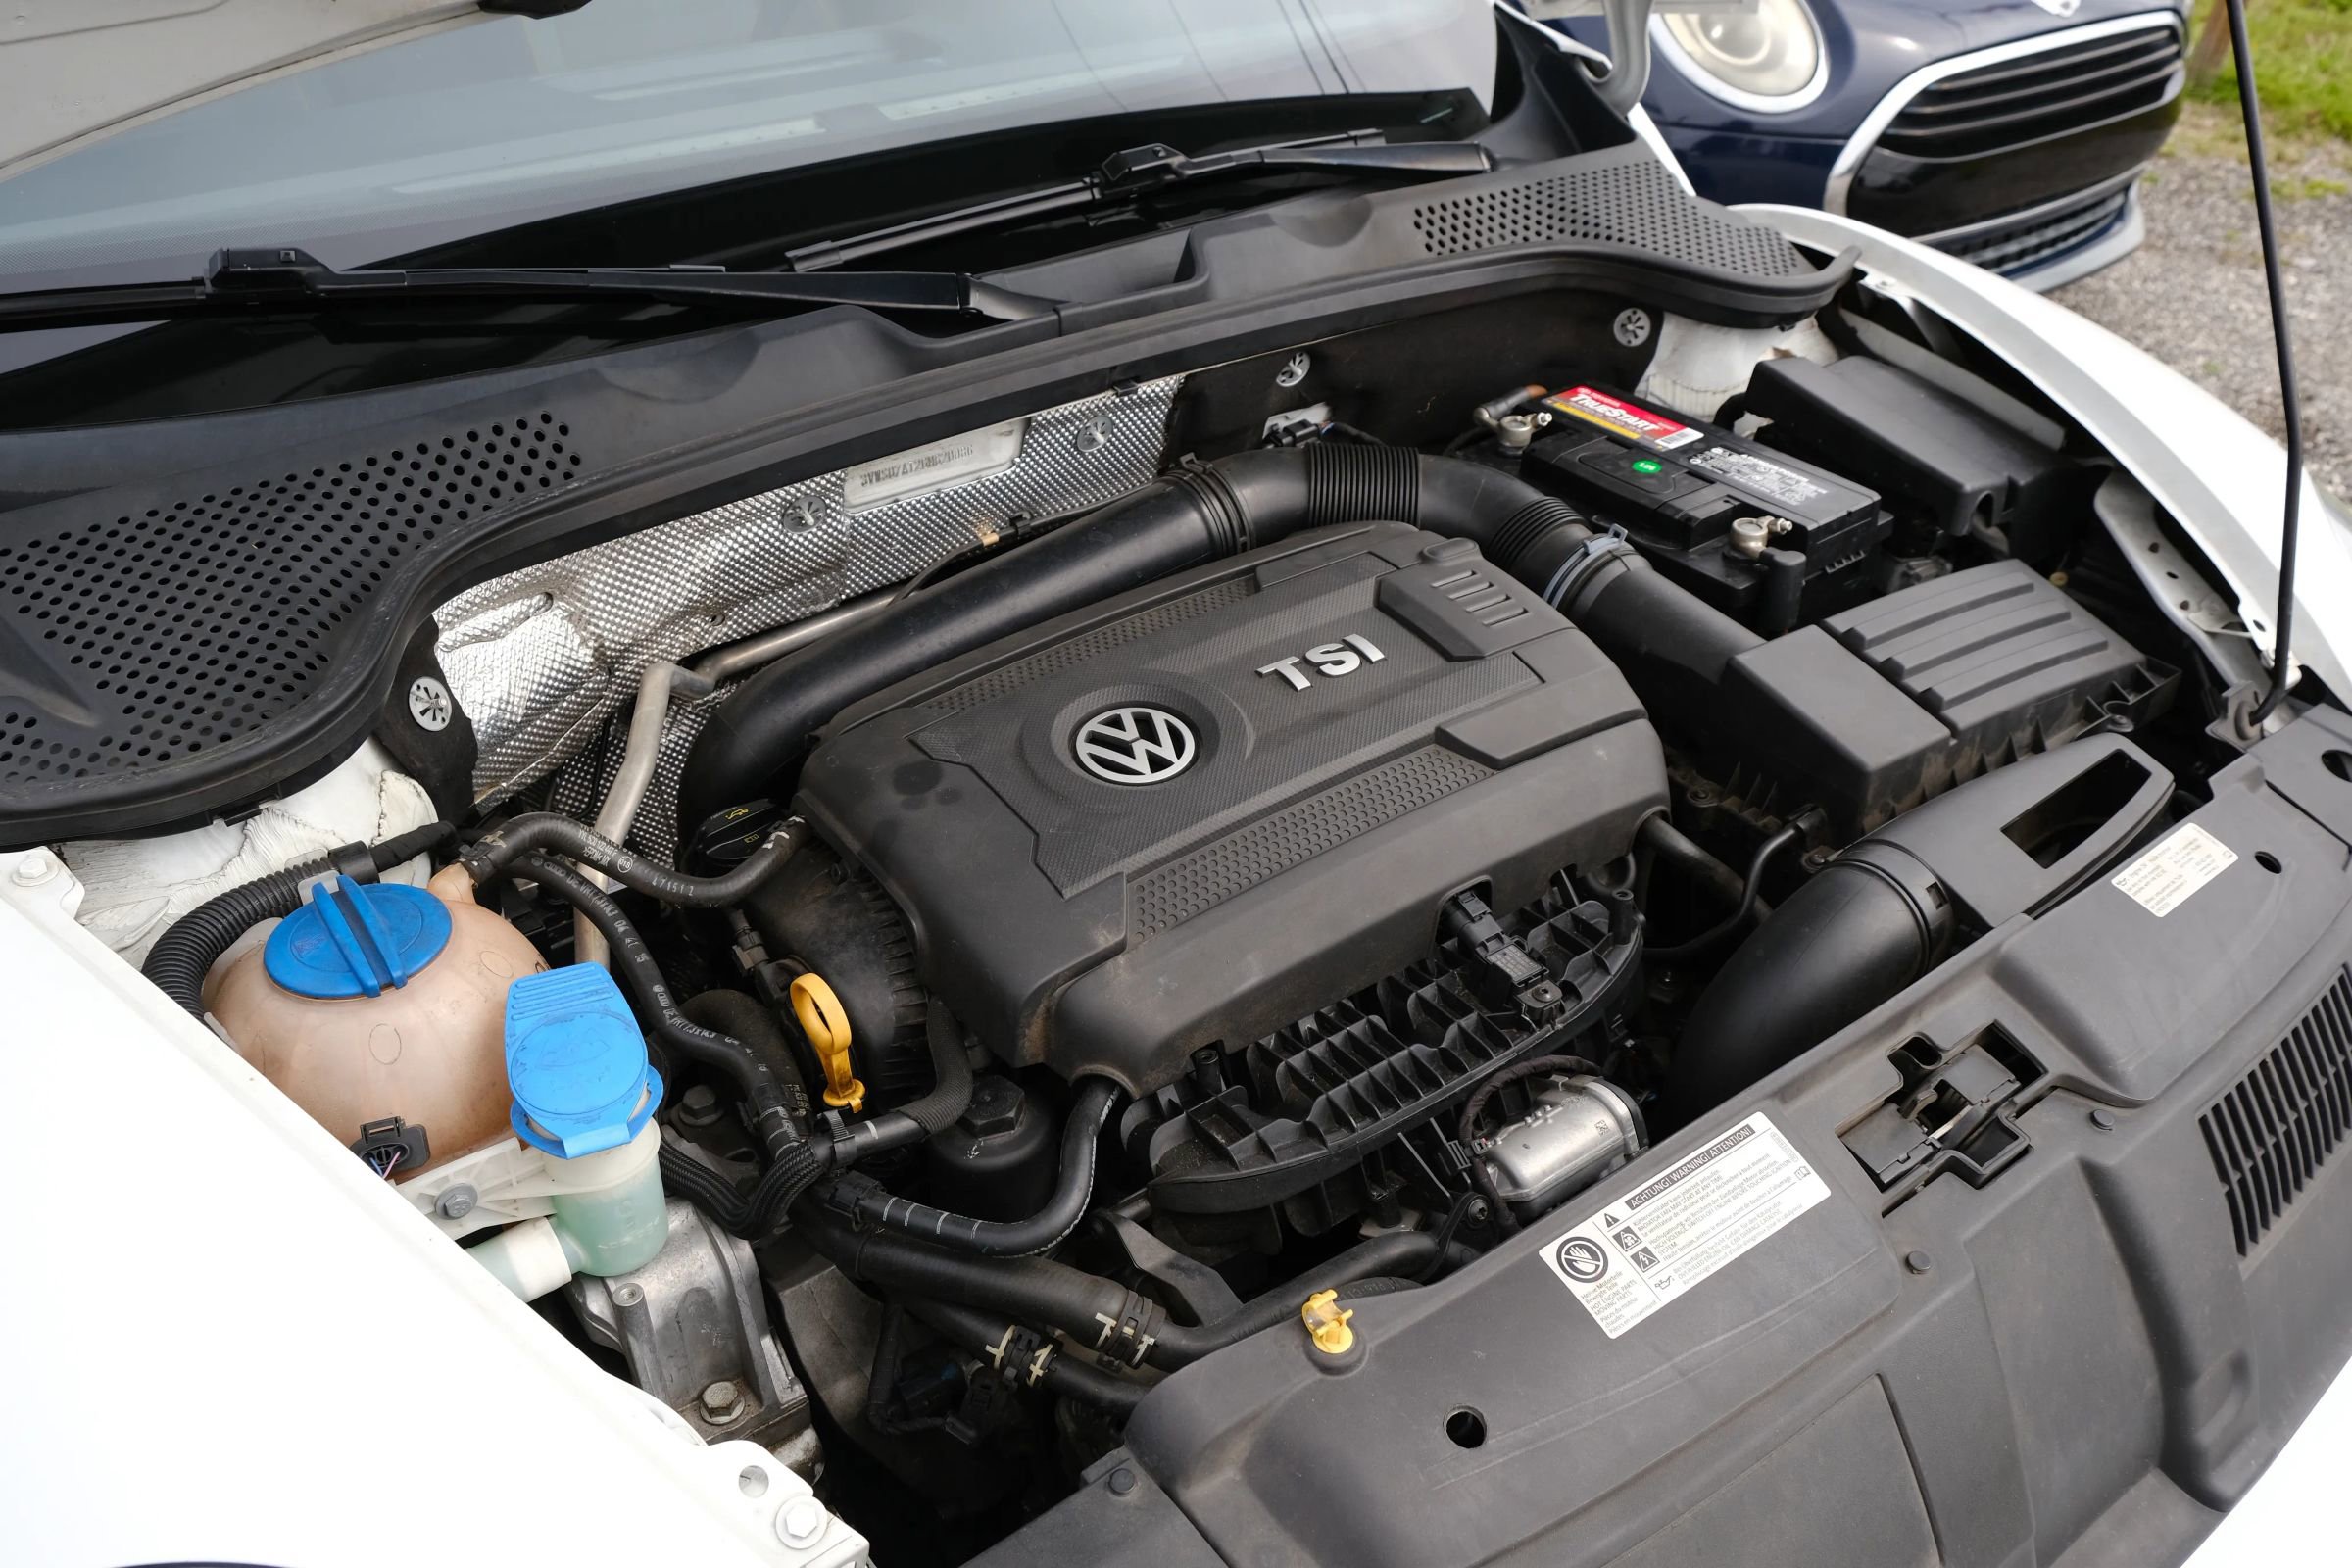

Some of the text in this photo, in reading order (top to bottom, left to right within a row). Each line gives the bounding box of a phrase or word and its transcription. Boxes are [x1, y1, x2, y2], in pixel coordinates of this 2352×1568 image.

[1255, 633, 1387, 693] TSI
[1629, 1177, 1672, 1207] ACHTUNG!
[1669, 1152, 1710, 1182] WARNING!
[1707, 1125, 1752, 1157] ATTENTION!
